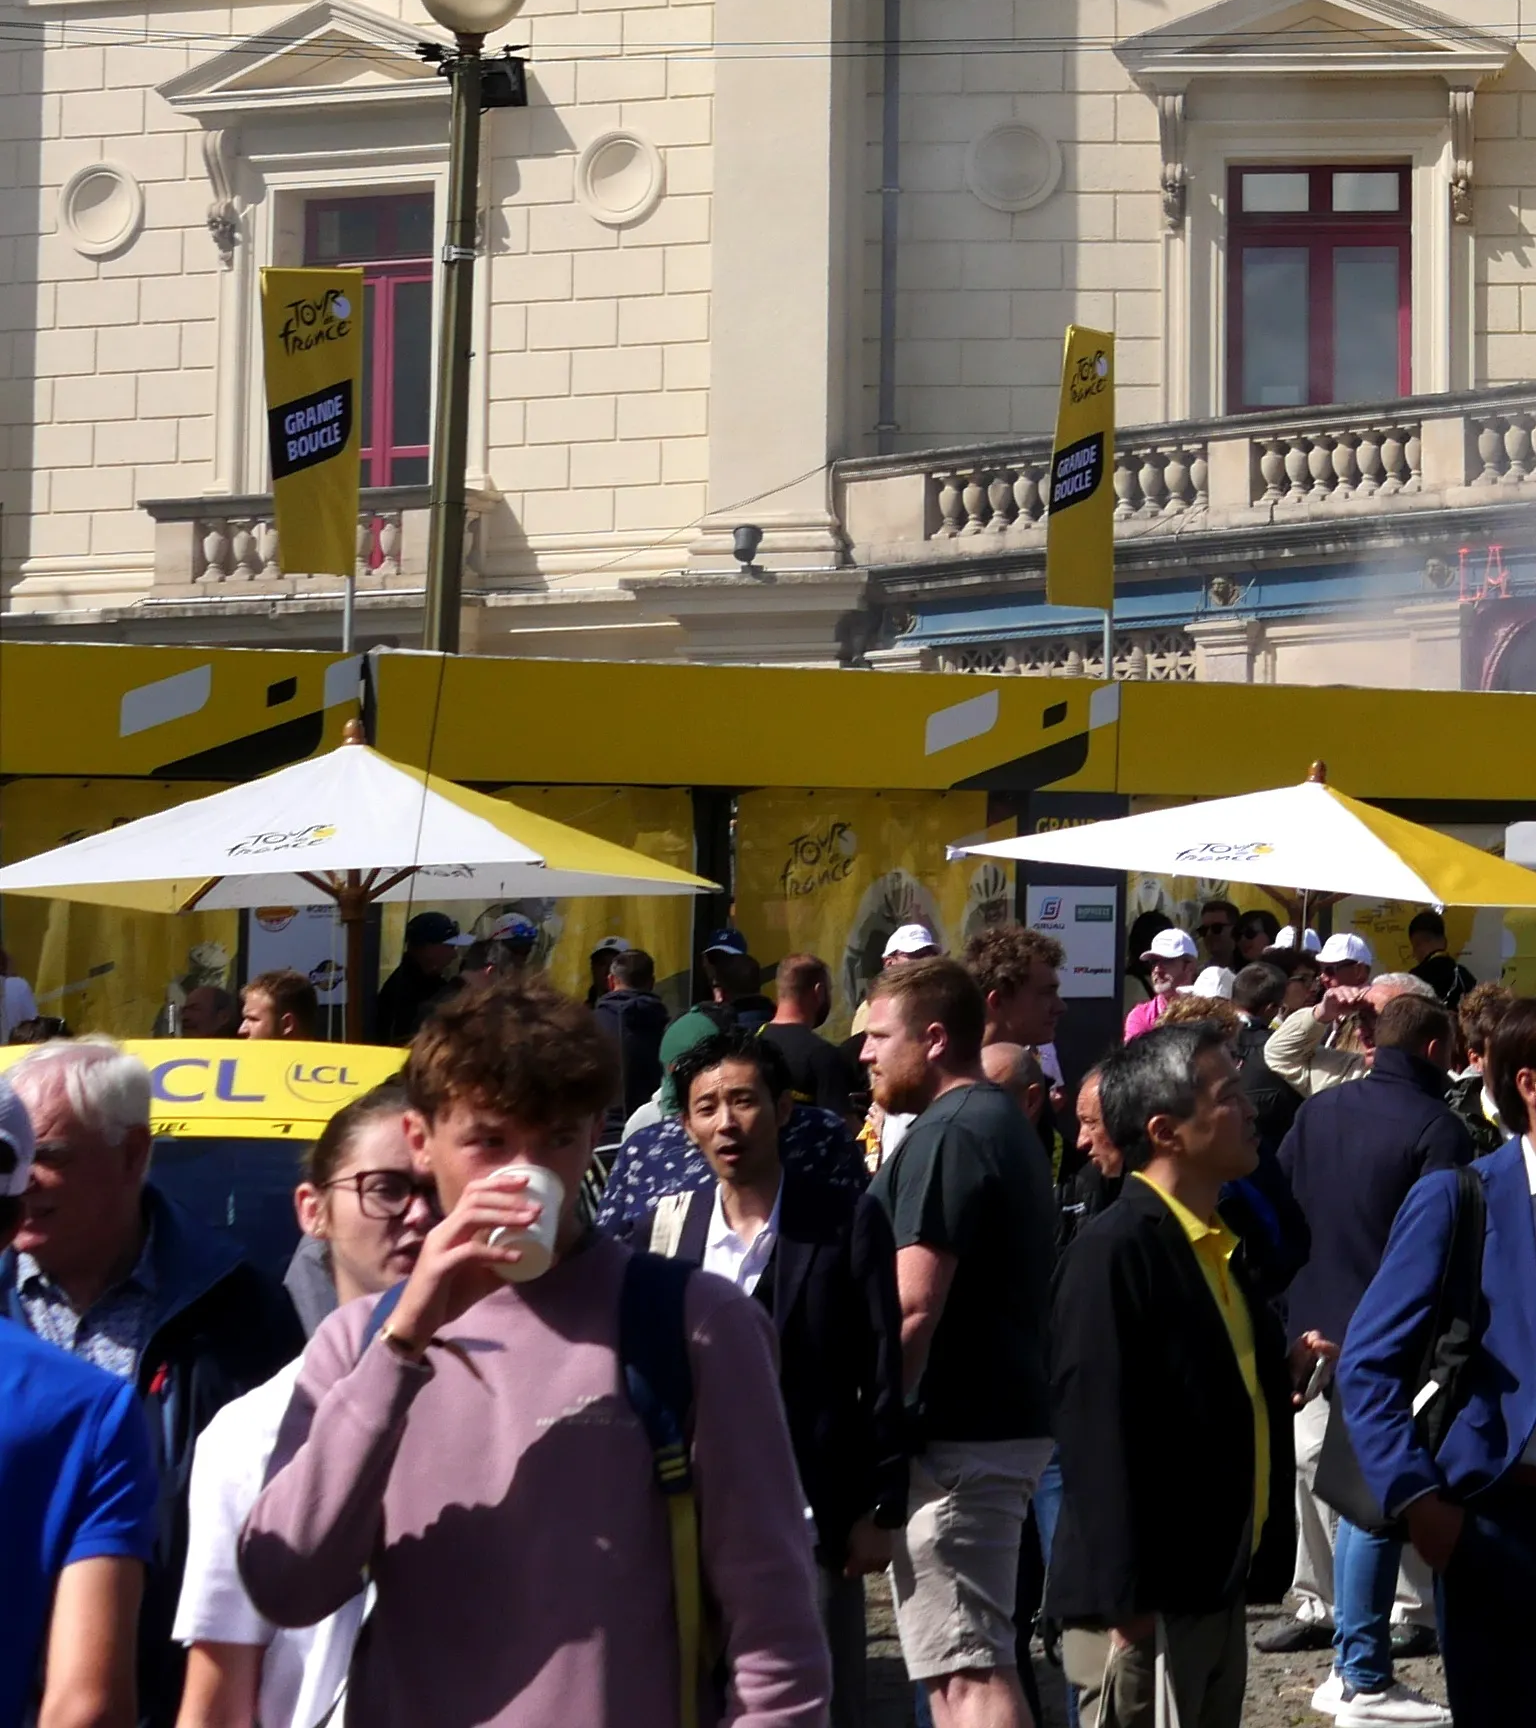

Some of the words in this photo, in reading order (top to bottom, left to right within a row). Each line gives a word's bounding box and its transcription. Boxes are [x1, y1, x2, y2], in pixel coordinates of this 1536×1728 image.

[284, 395, 344, 435] GRANDE
[286, 422, 342, 462] BOUCLE
[1057, 444, 1097, 478] GRANDE
[1054, 469, 1092, 502] BOUCLE
[1458, 544, 1512, 602] LA
[149, 1058, 267, 1103] CL
[293, 1064, 359, 1085] LCL
